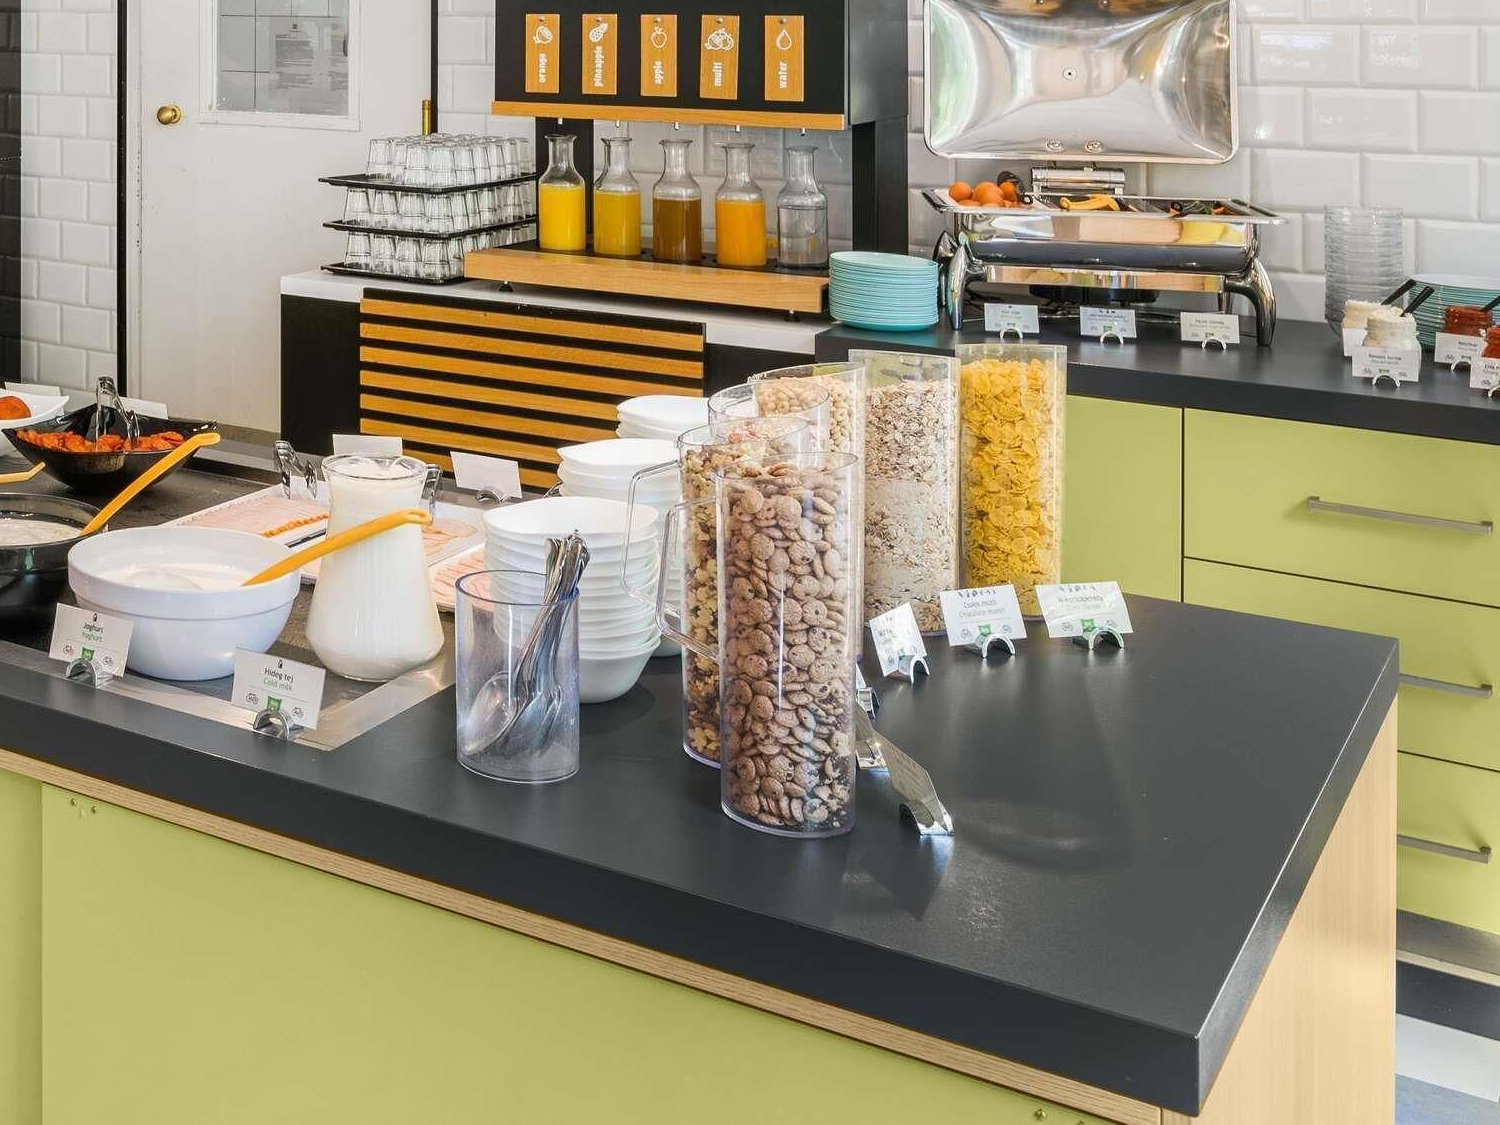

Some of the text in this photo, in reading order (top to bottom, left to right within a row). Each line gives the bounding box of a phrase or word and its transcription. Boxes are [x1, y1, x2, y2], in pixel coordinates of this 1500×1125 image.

[538, 53, 547, 83] orange
[594, 45, 603, 87] pineapple
[655, 60, 663, 85] apple
[714, 61, 723, 87] multi
[779, 61, 788, 89] water
[263, 678, 292, 692] Cold milk
[264, 668, 294, 683] Hideg tej
